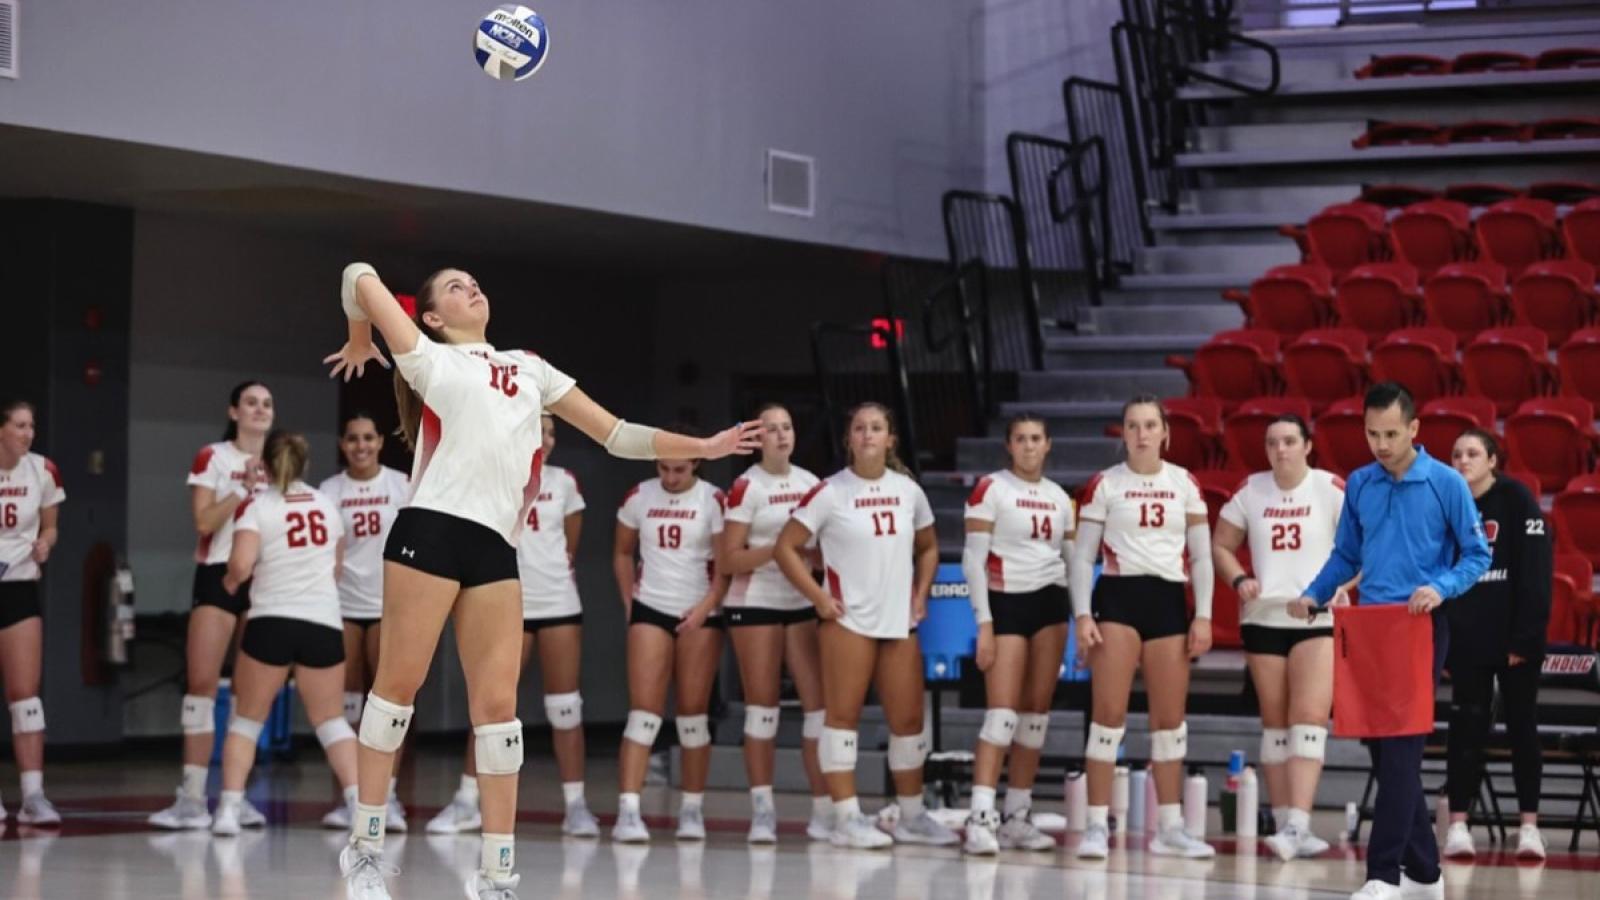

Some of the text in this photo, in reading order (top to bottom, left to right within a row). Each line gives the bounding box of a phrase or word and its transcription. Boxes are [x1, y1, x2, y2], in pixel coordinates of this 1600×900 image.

[646, 508, 697, 520] CARDINALS
[855, 496, 901, 509] CARDINALS
[1262, 505, 1312, 518] CARDINALS
[352, 511, 381, 538] 28
[872, 511, 896, 536] 17
[1031, 515, 1053, 541] 14
[1138, 503, 1165, 528] 13
[1525, 519, 1545, 535] 22
[285, 509, 329, 548] 26
[657, 525, 682, 549] 19
[1271, 523, 1301, 551] 23
